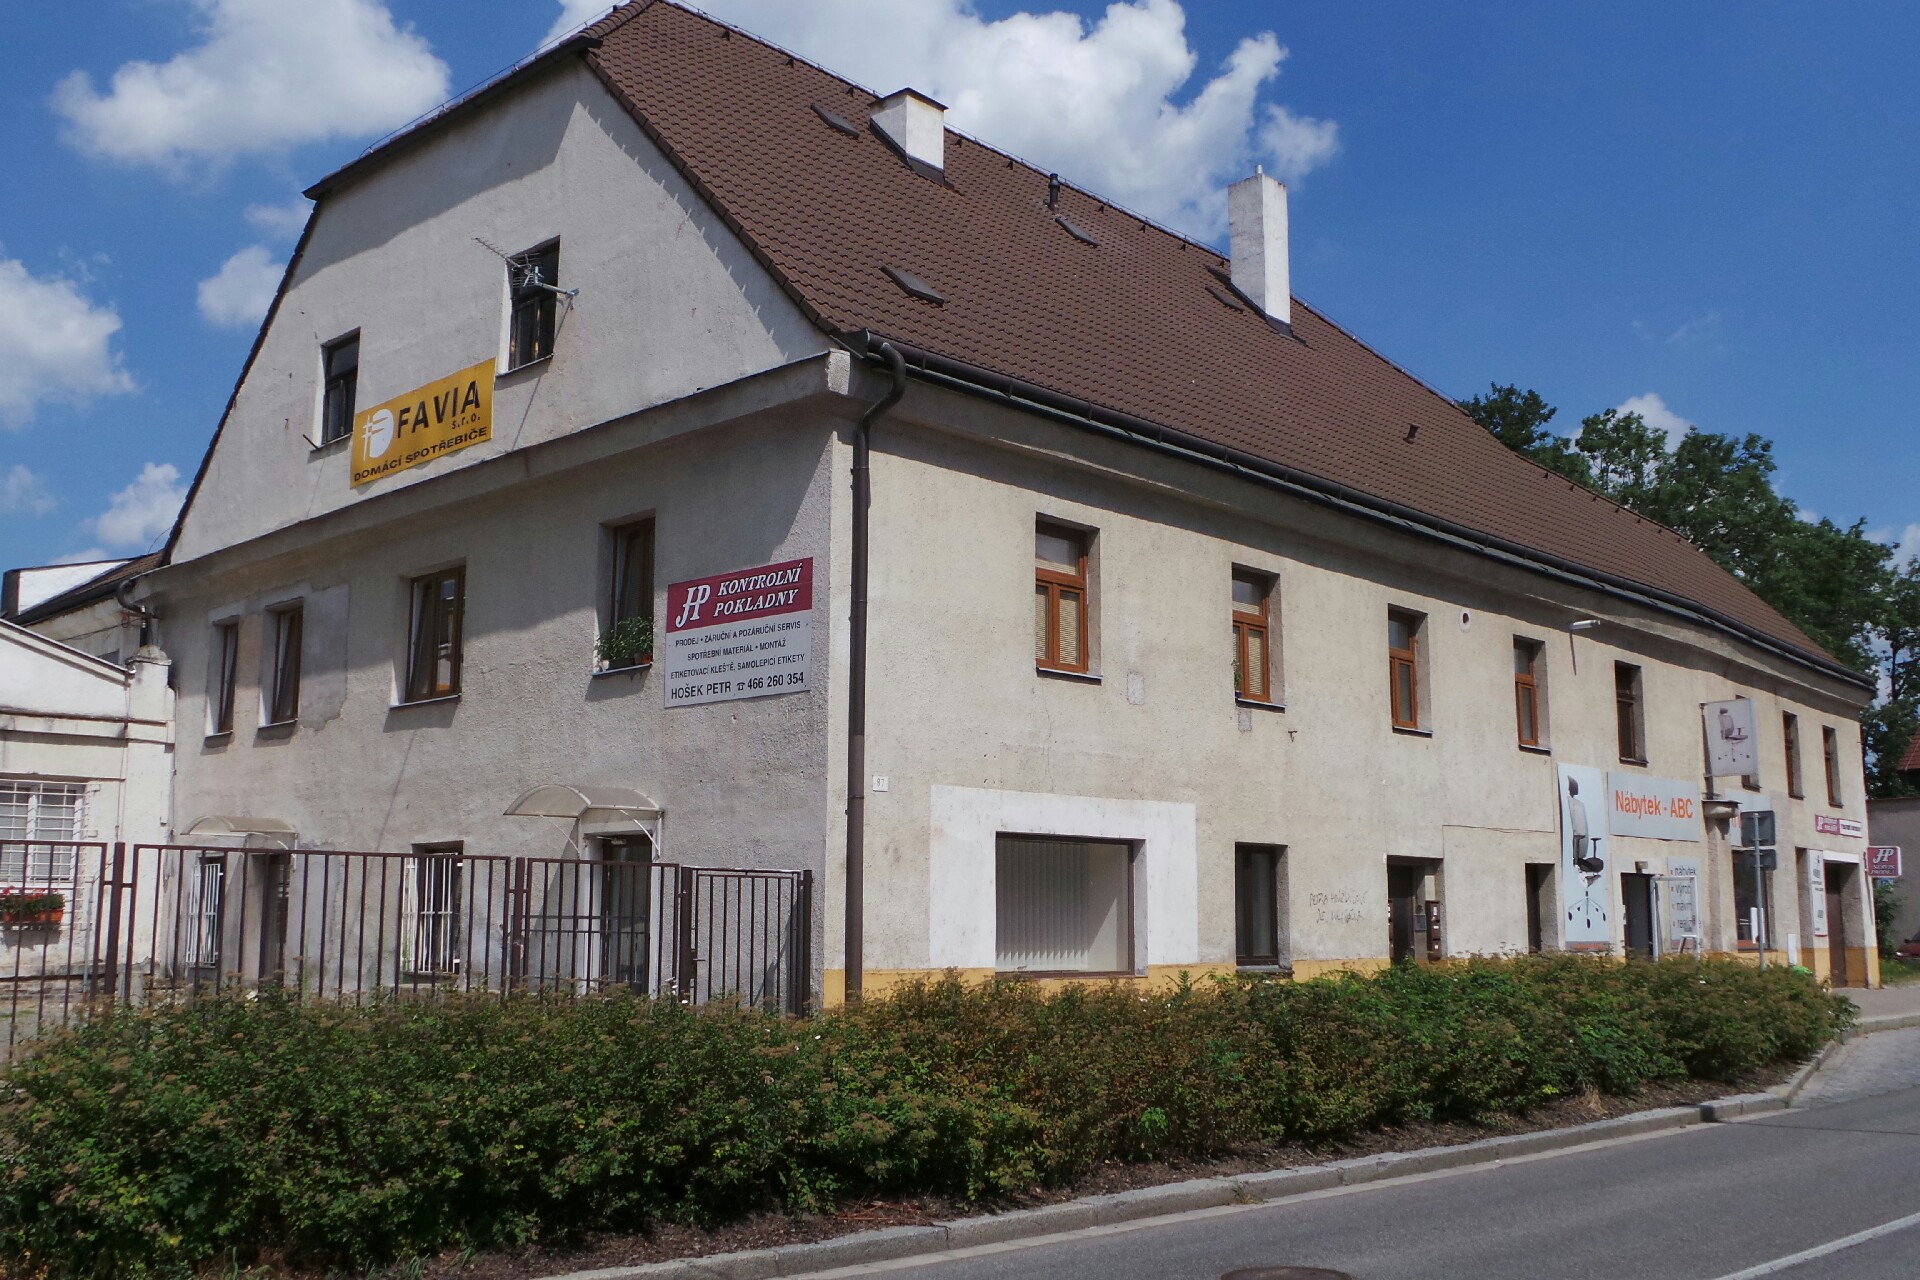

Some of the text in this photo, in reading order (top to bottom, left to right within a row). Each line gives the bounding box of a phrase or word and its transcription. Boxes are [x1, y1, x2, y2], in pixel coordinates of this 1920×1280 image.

[397, 380, 480, 438] FAVIA
[451, 413, 480, 430] s.r.o.
[354, 426, 487, 482] DOMÁCÍ SPOTŘEBIČE
[718, 562, 803, 596] KONTROLNÍ
[713, 589, 799, 617] POKLADNY
[675, 620, 801, 647] PRODEJ ZÁRUČNÍ A POZÁRUČNÍ SERVIS
[687, 637, 787, 661] SPOTŘEBNÍ MATERIÁL MONTÁŽ
[670, 665, 710, 680] ETIKETOVACÍ
[777, 653, 805, 665] ETIKETY
[671, 671, 804, 700] HOŠEK PETR 466 260 354
[1615, 789, 1661, 820] Nábytek
[1670, 797, 1693, 819] ABC
